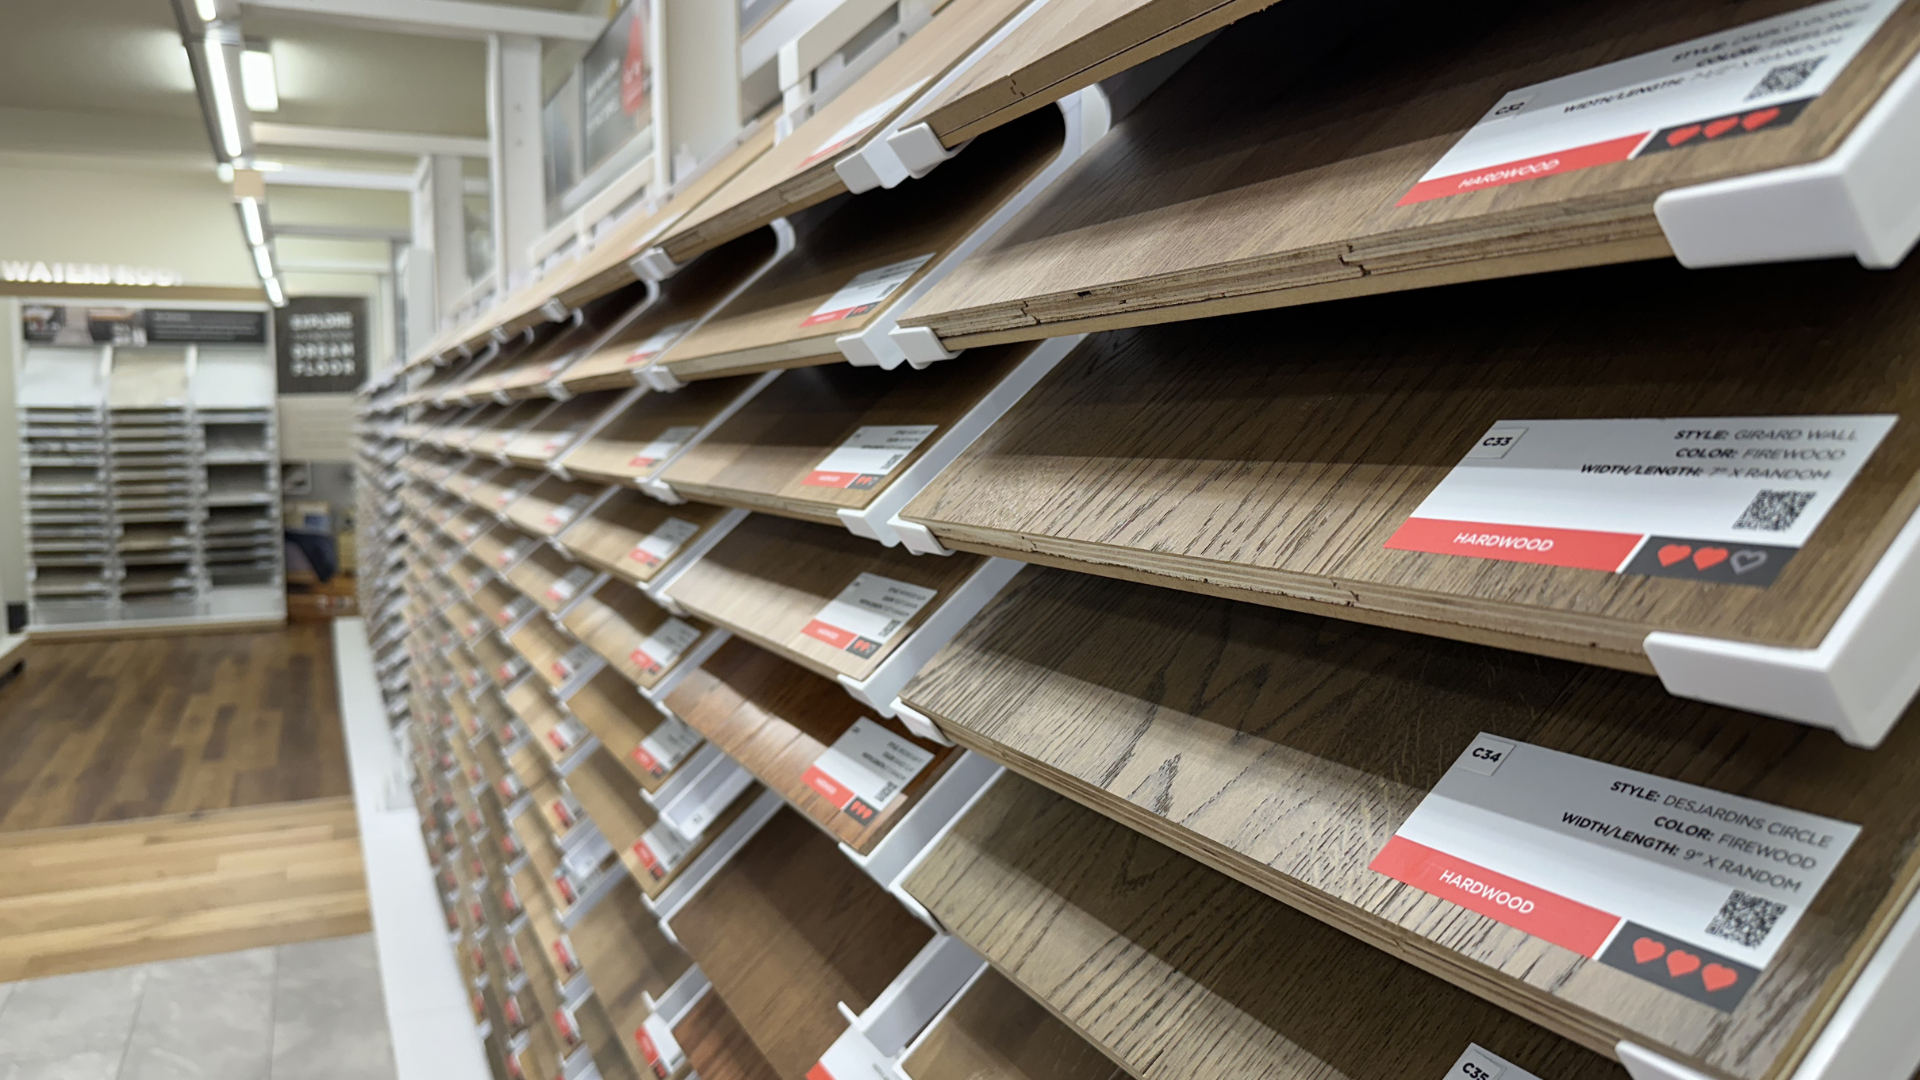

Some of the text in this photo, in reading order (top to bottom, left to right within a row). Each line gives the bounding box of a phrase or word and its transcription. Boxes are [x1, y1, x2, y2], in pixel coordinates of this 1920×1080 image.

[1458, 159, 1560, 188] HARDWOOD
[1482, 436, 1513, 447] C33
[1674, 429, 1858, 441] STYLE: GIRARD WALL
[1675, 448, 1846, 461] COLOR: FIREWOOD
[1580, 464, 1703, 477] WIDTH/LENGTH:
[1728, 467, 1744, 477] X
[1744, 467, 1832, 480] RANDOM
[1453, 532, 1554, 552] HARDWOOD
[1471, 745, 1502, 765] C34
[1609, 780, 1835, 850] STYLE: DESJARDINS CIRCLE
[1561, 811, 1802, 893] WIDTH/LENGTH: 9" X RANDOM
[1653, 815, 1817, 872] COLOR: FIREWOOD
[1438, 869, 1535, 915] HARDWOOD
[1462, 1062, 1490, 1080] C35
